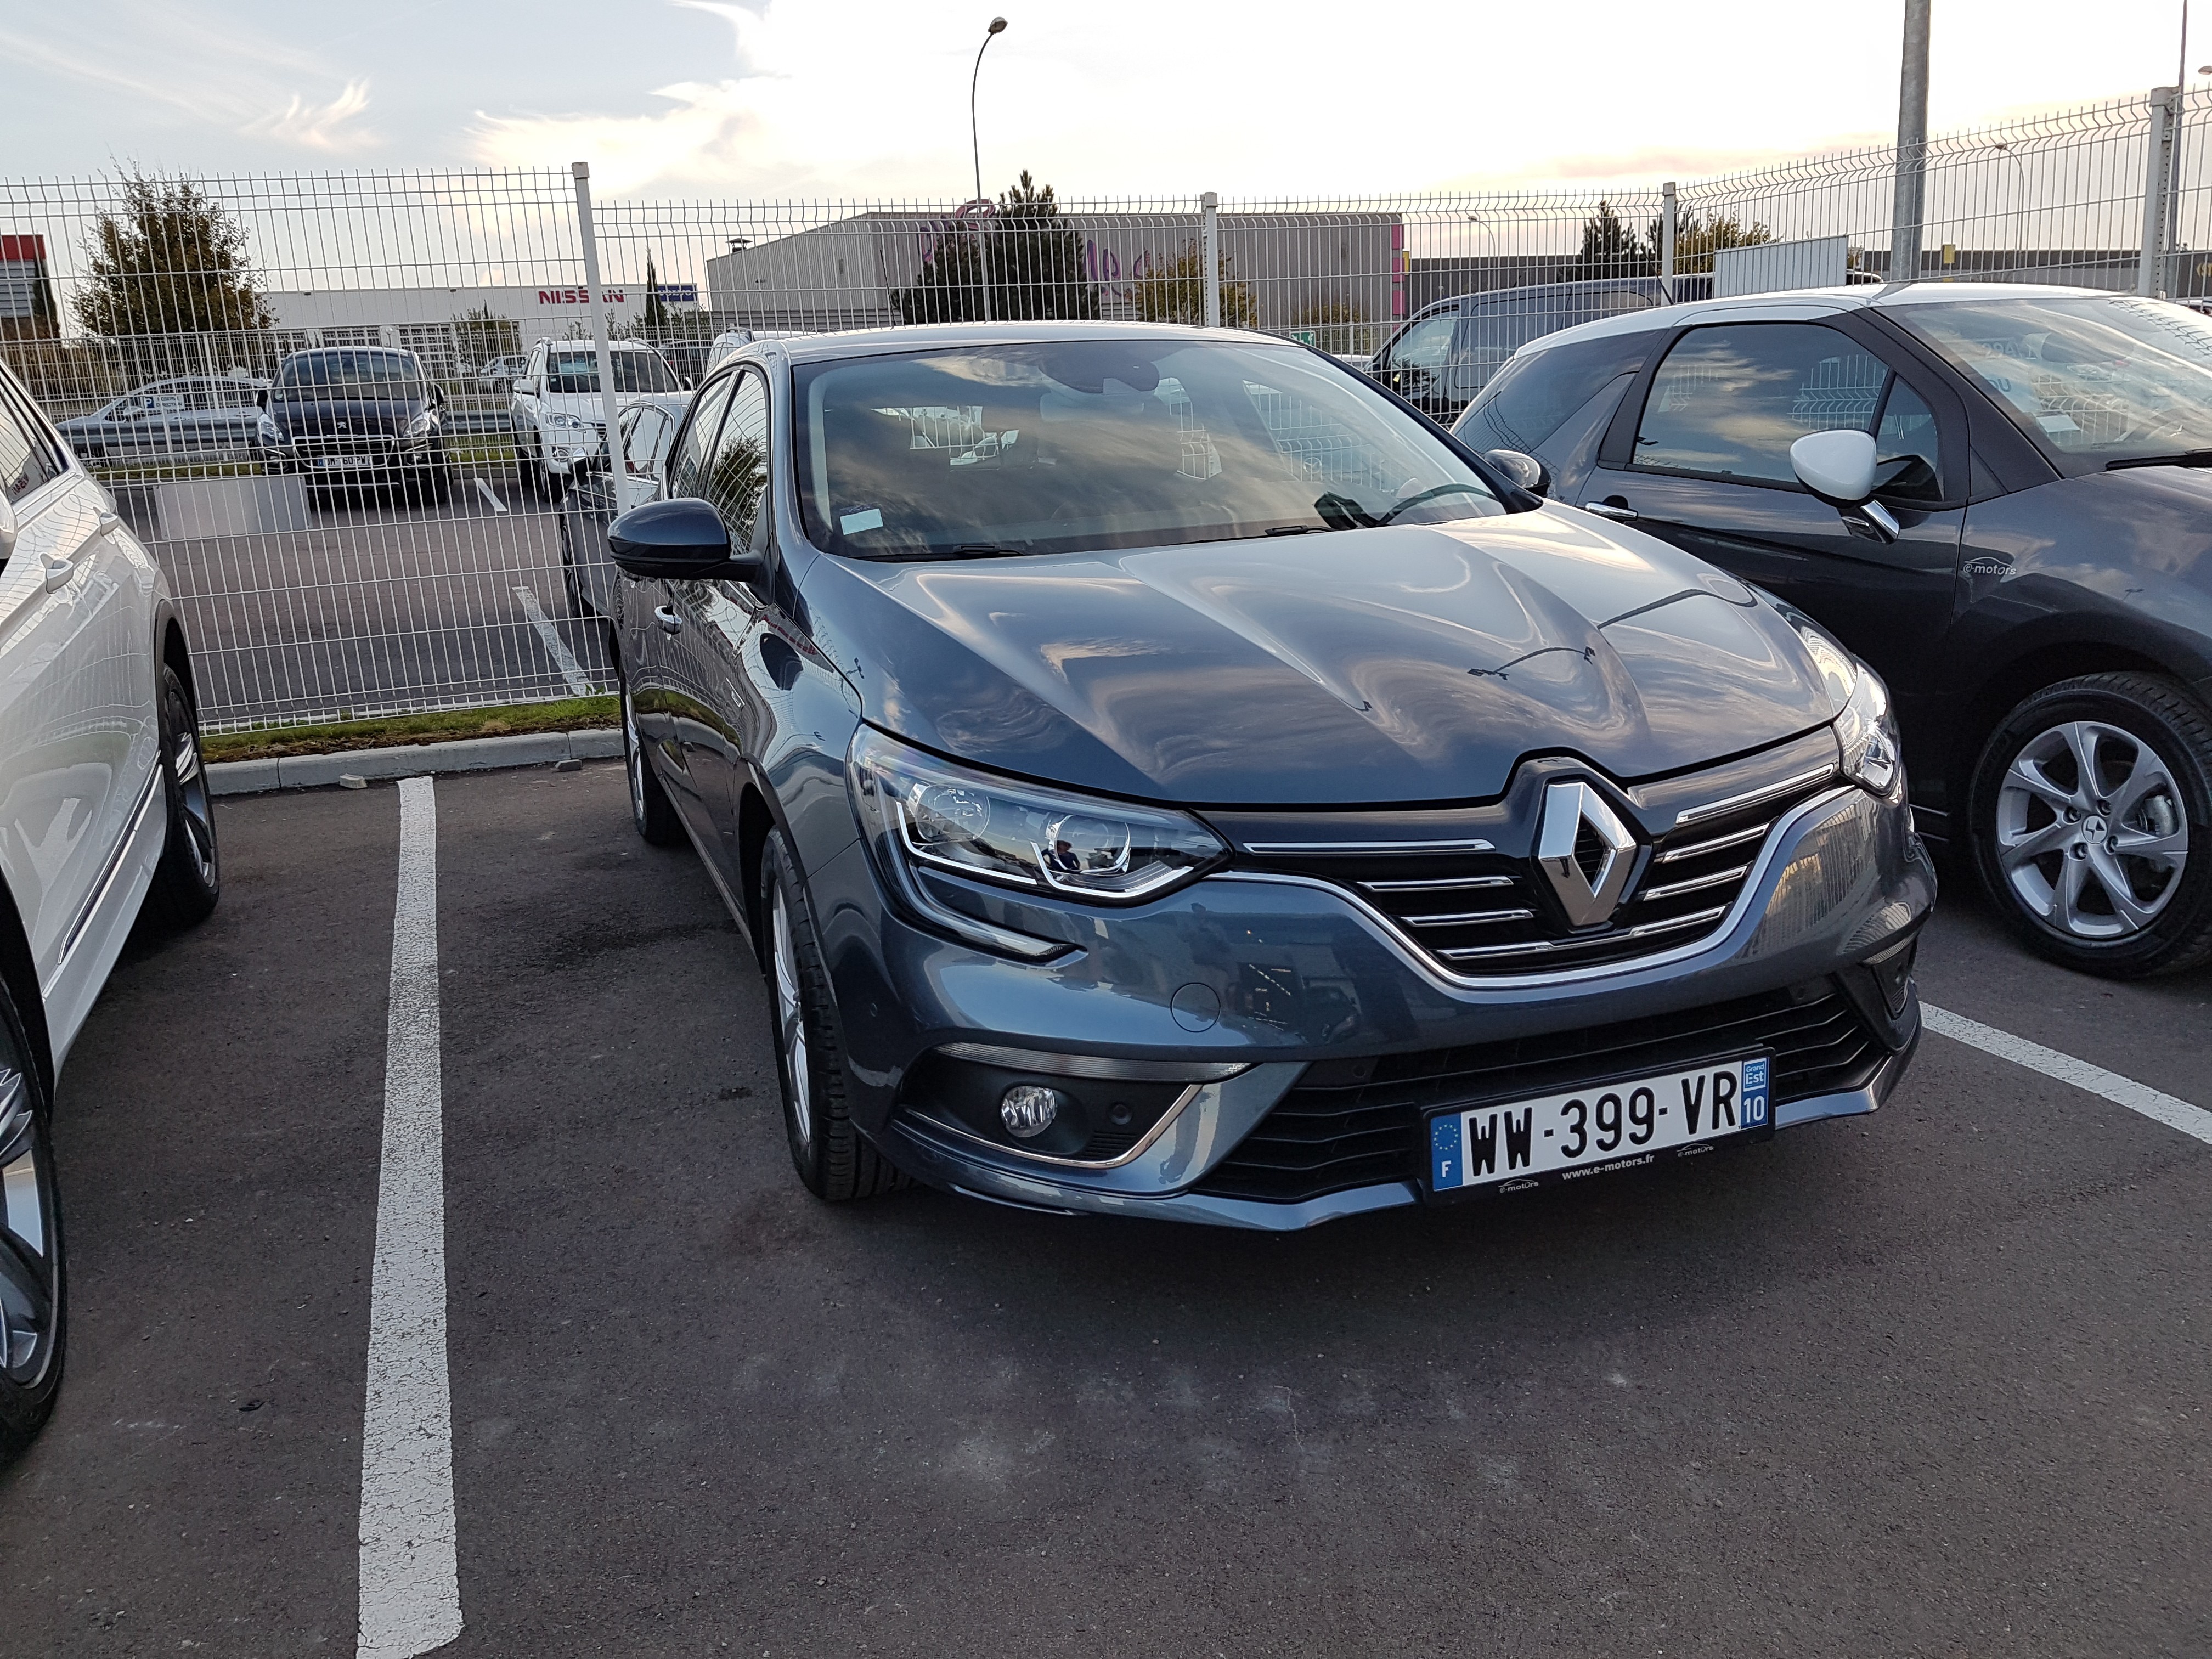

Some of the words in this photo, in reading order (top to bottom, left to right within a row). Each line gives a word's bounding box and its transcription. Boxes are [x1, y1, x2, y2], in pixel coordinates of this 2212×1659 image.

[1746, 1063, 1764, 1072] Grand
[1746, 1070, 1764, 1085] Est
[1743, 1095, 1765, 1124] 10
[1468, 1070, 1737, 1177] WW-399-VR
[1441, 1160, 1452, 1178] F
[1561, 1154, 1655, 1180] www.e-motors.fr
